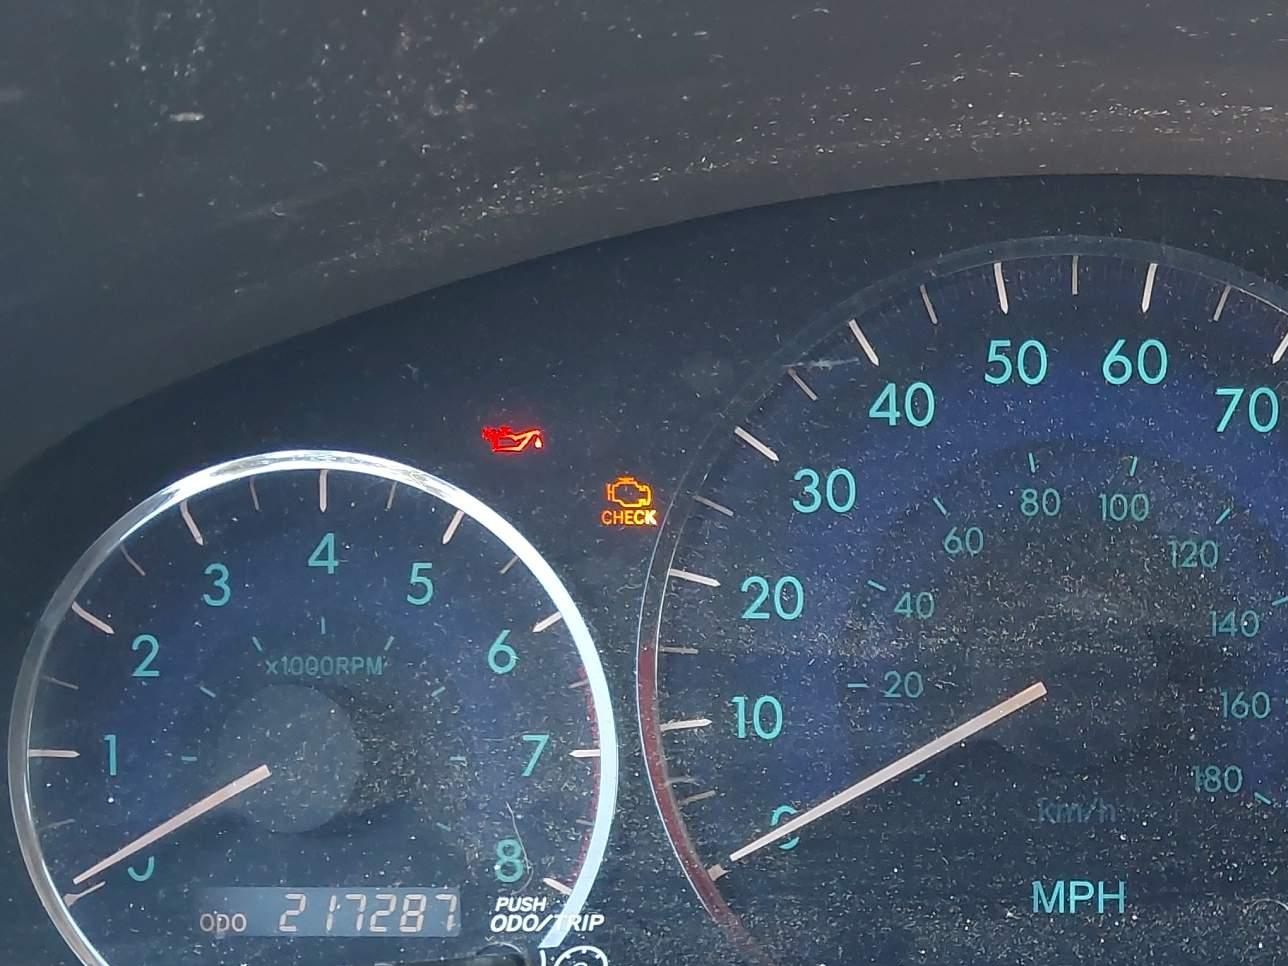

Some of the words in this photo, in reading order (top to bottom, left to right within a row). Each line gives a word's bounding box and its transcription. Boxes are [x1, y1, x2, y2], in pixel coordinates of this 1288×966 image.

[985, 340, 1048, 386] 50
[1103, 339, 1168, 386] 60
[869, 383, 935, 427] 40
[1215, 388, 1279, 433] 70
[793, 469, 855, 514] 30
[1020, 489, 1061, 518] 80
[1099, 493, 1149, 522] 100
[602, 509, 657, 526] CHECK
[308, 533, 336, 573] 4
[944, 528, 984, 556] 60
[1171, 540, 1219, 569] 120
[203, 565, 230, 606] 3
[408, 563, 433, 605] 5
[741, 577, 803, 621] 20
[894, 592, 936, 620] 40
[1211, 610, 1260, 638] 140
[134, 635, 160, 676] 2
[488, 630, 516, 673] 6
[884, 671, 924, 699] 20
[732, 695, 782, 740] 10
[1221, 692, 1270, 719] 160
[104, 734, 117, 776] 1
[522, 734, 549, 776] 7
[1195, 766, 1243, 794] 180
[1038, 797, 1116, 824] km/h
[496, 840, 524, 882] 8
[279, 893, 456, 932] 217287
[496, 897, 546, 912] PUSH
[1032, 880, 1125, 915] MPH
[490, 914, 604, 933] ODO/TRIP
